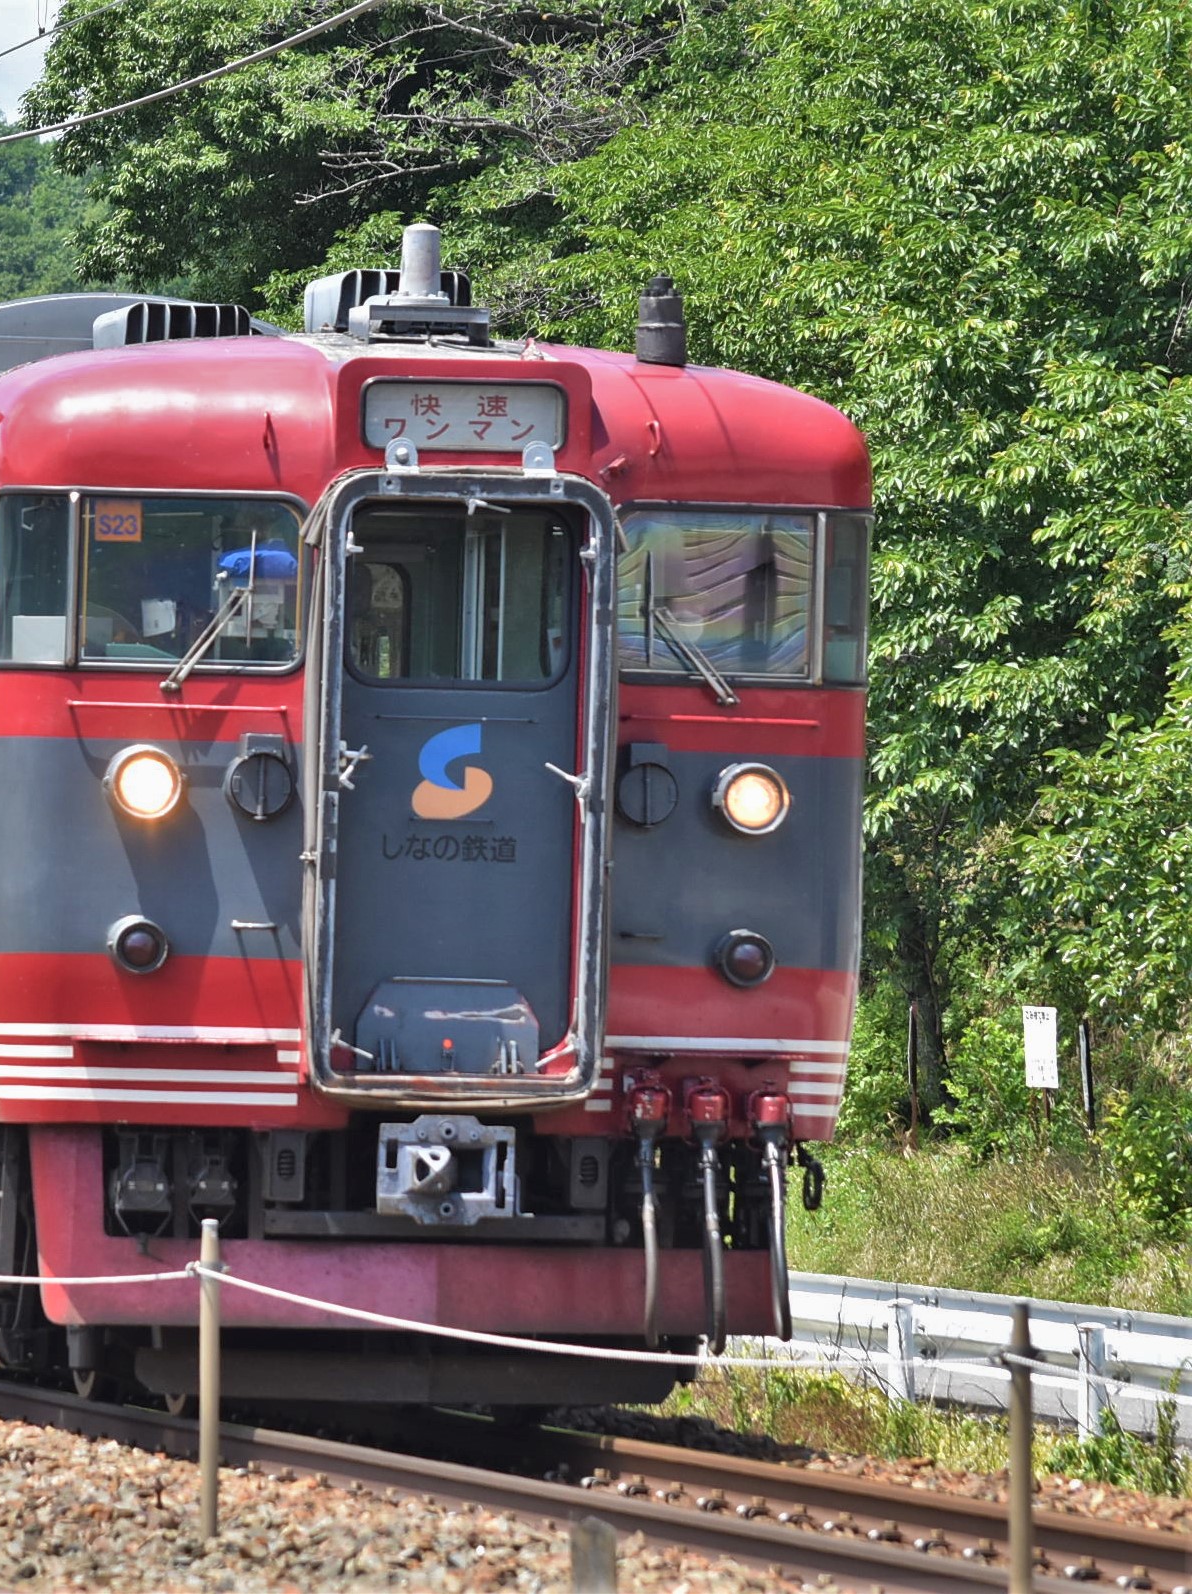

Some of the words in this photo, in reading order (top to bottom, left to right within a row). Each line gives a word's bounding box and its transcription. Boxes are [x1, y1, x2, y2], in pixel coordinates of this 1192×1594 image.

[411, 393, 509, 418] 快速
[384, 418, 535, 441] ワンマン
[99, 513, 138, 536] S23
[381, 833, 518, 864] しなの鉄道
